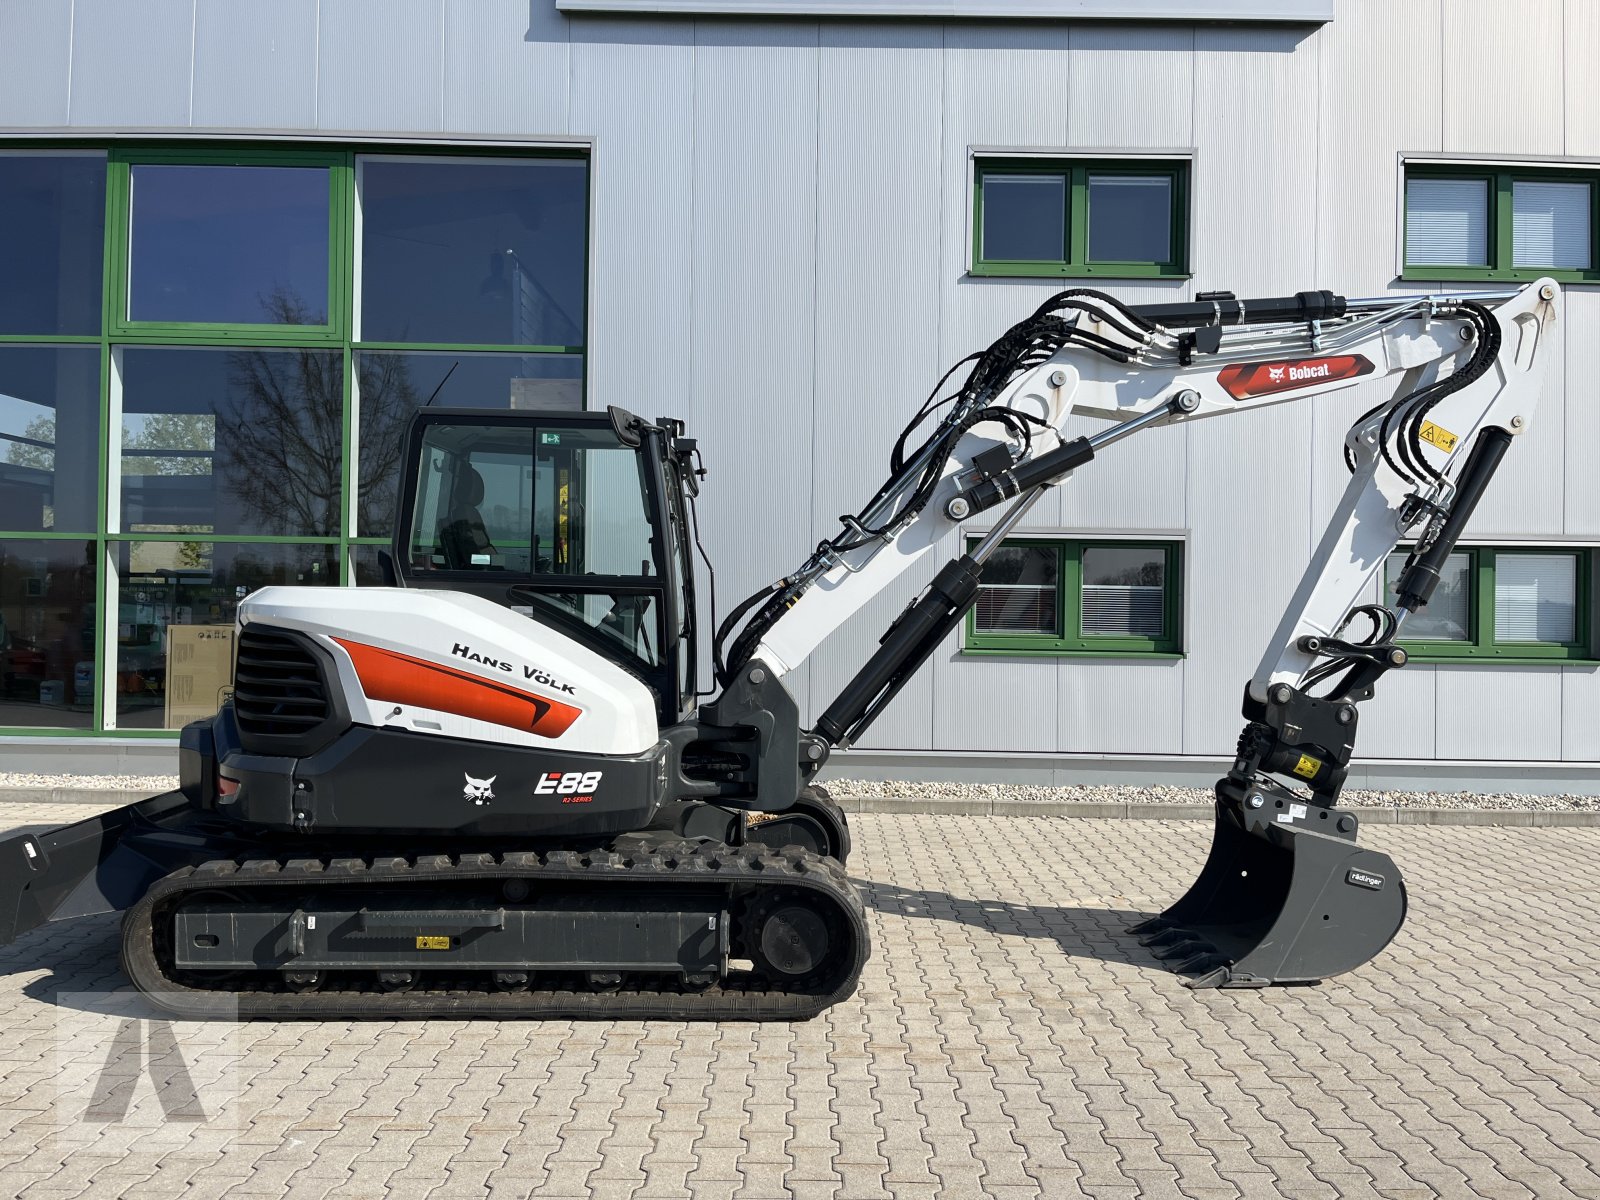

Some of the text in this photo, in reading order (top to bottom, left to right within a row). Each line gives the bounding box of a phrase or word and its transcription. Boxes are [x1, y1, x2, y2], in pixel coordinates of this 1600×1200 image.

[1289, 364, 1329, 380] Bobcat
[451, 643, 576, 695] HANS VÖLK
[534, 771, 602, 794] E88
